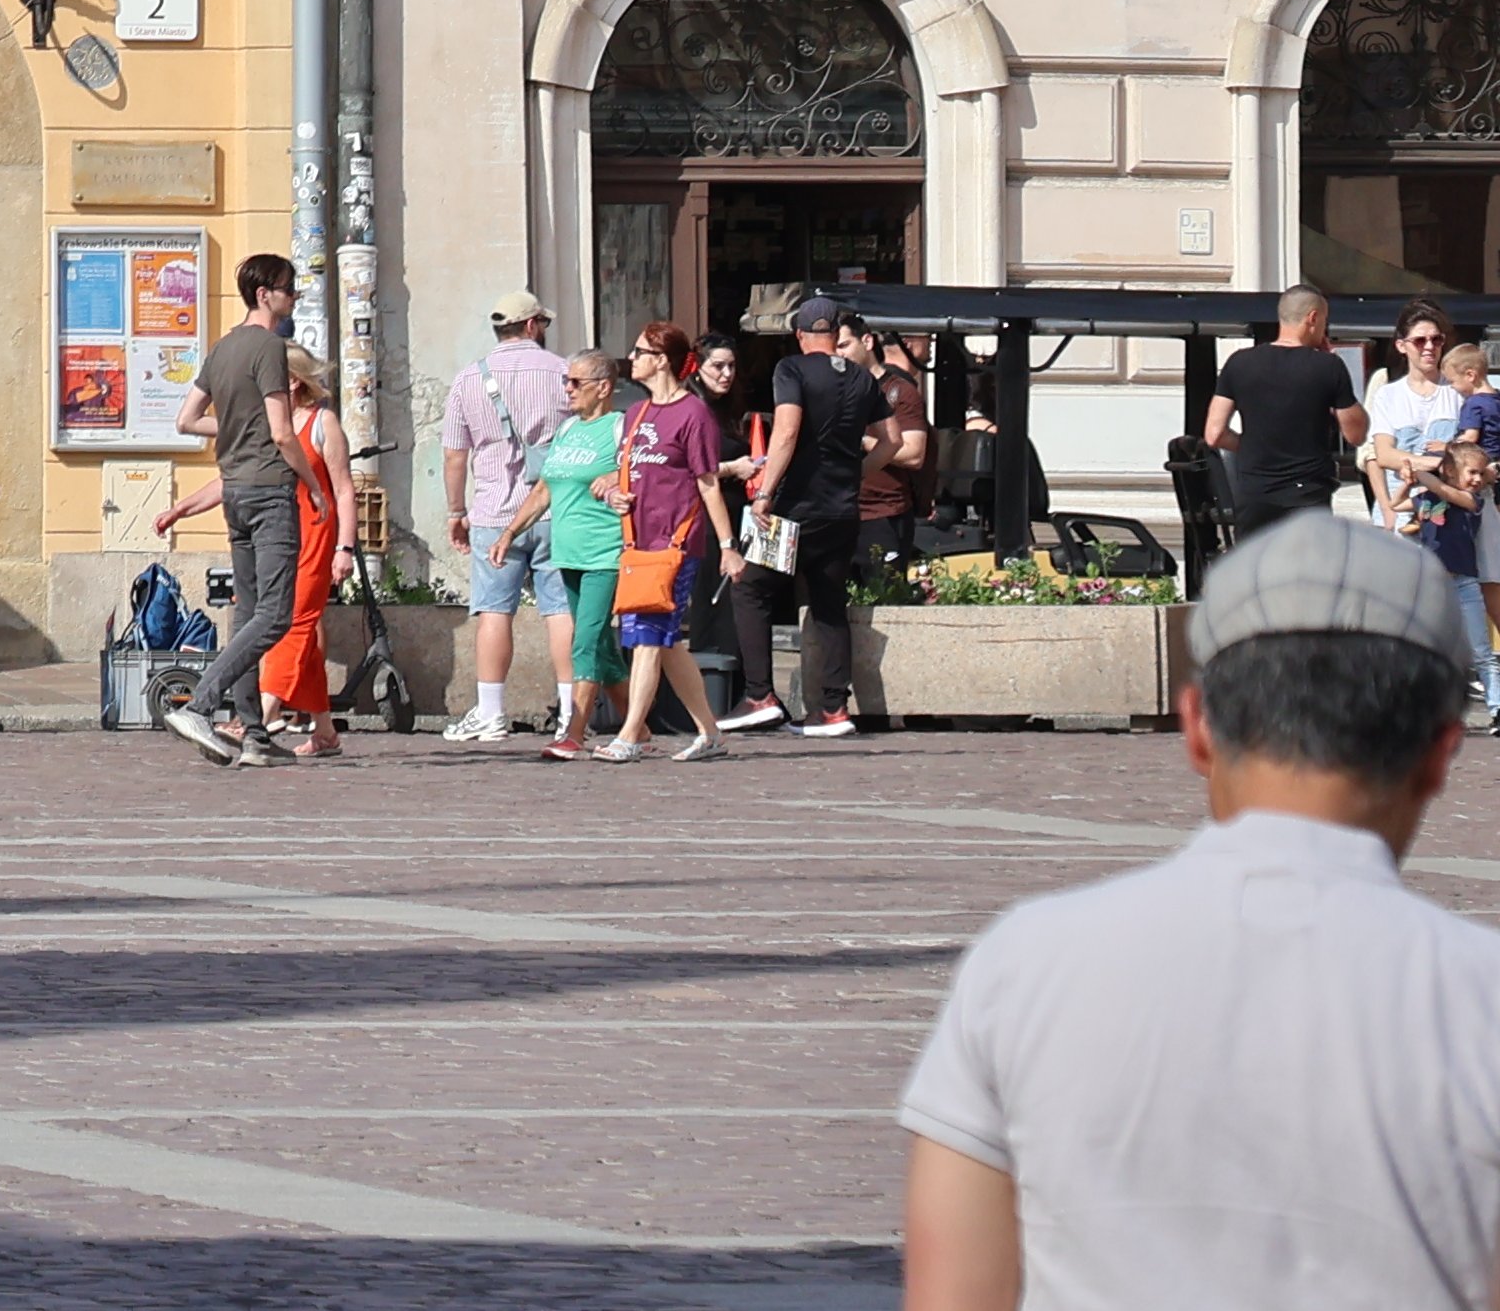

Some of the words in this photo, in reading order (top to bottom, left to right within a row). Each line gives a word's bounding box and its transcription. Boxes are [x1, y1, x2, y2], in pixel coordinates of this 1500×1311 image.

[134, 28, 156, 36] Stare
[158, 28, 187, 36] Miasto
[58, 238, 119, 248] Krakowskie
[121, 239, 155, 248] Forum
[157, 240, 198, 251] Kultury
